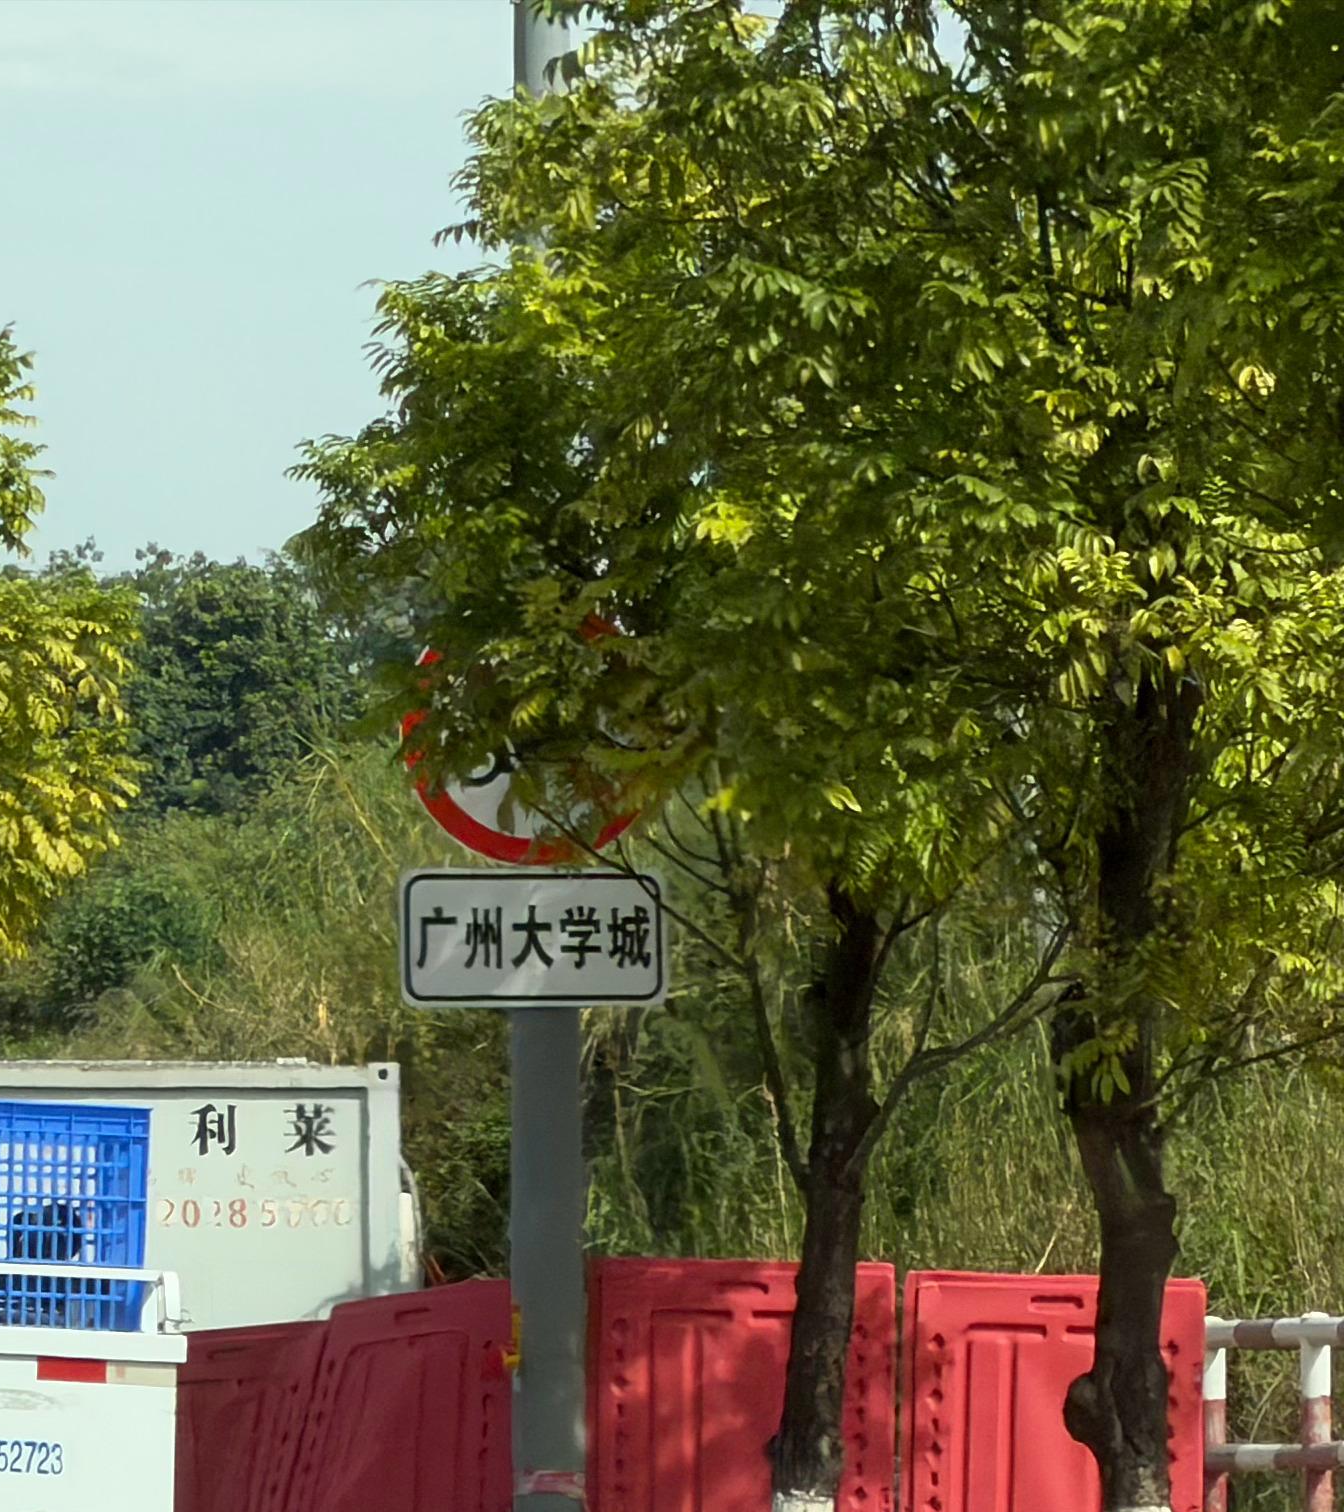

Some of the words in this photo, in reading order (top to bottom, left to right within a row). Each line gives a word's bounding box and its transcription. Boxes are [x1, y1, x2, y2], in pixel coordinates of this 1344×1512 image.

[417, 905, 652, 969] 广州大学城
